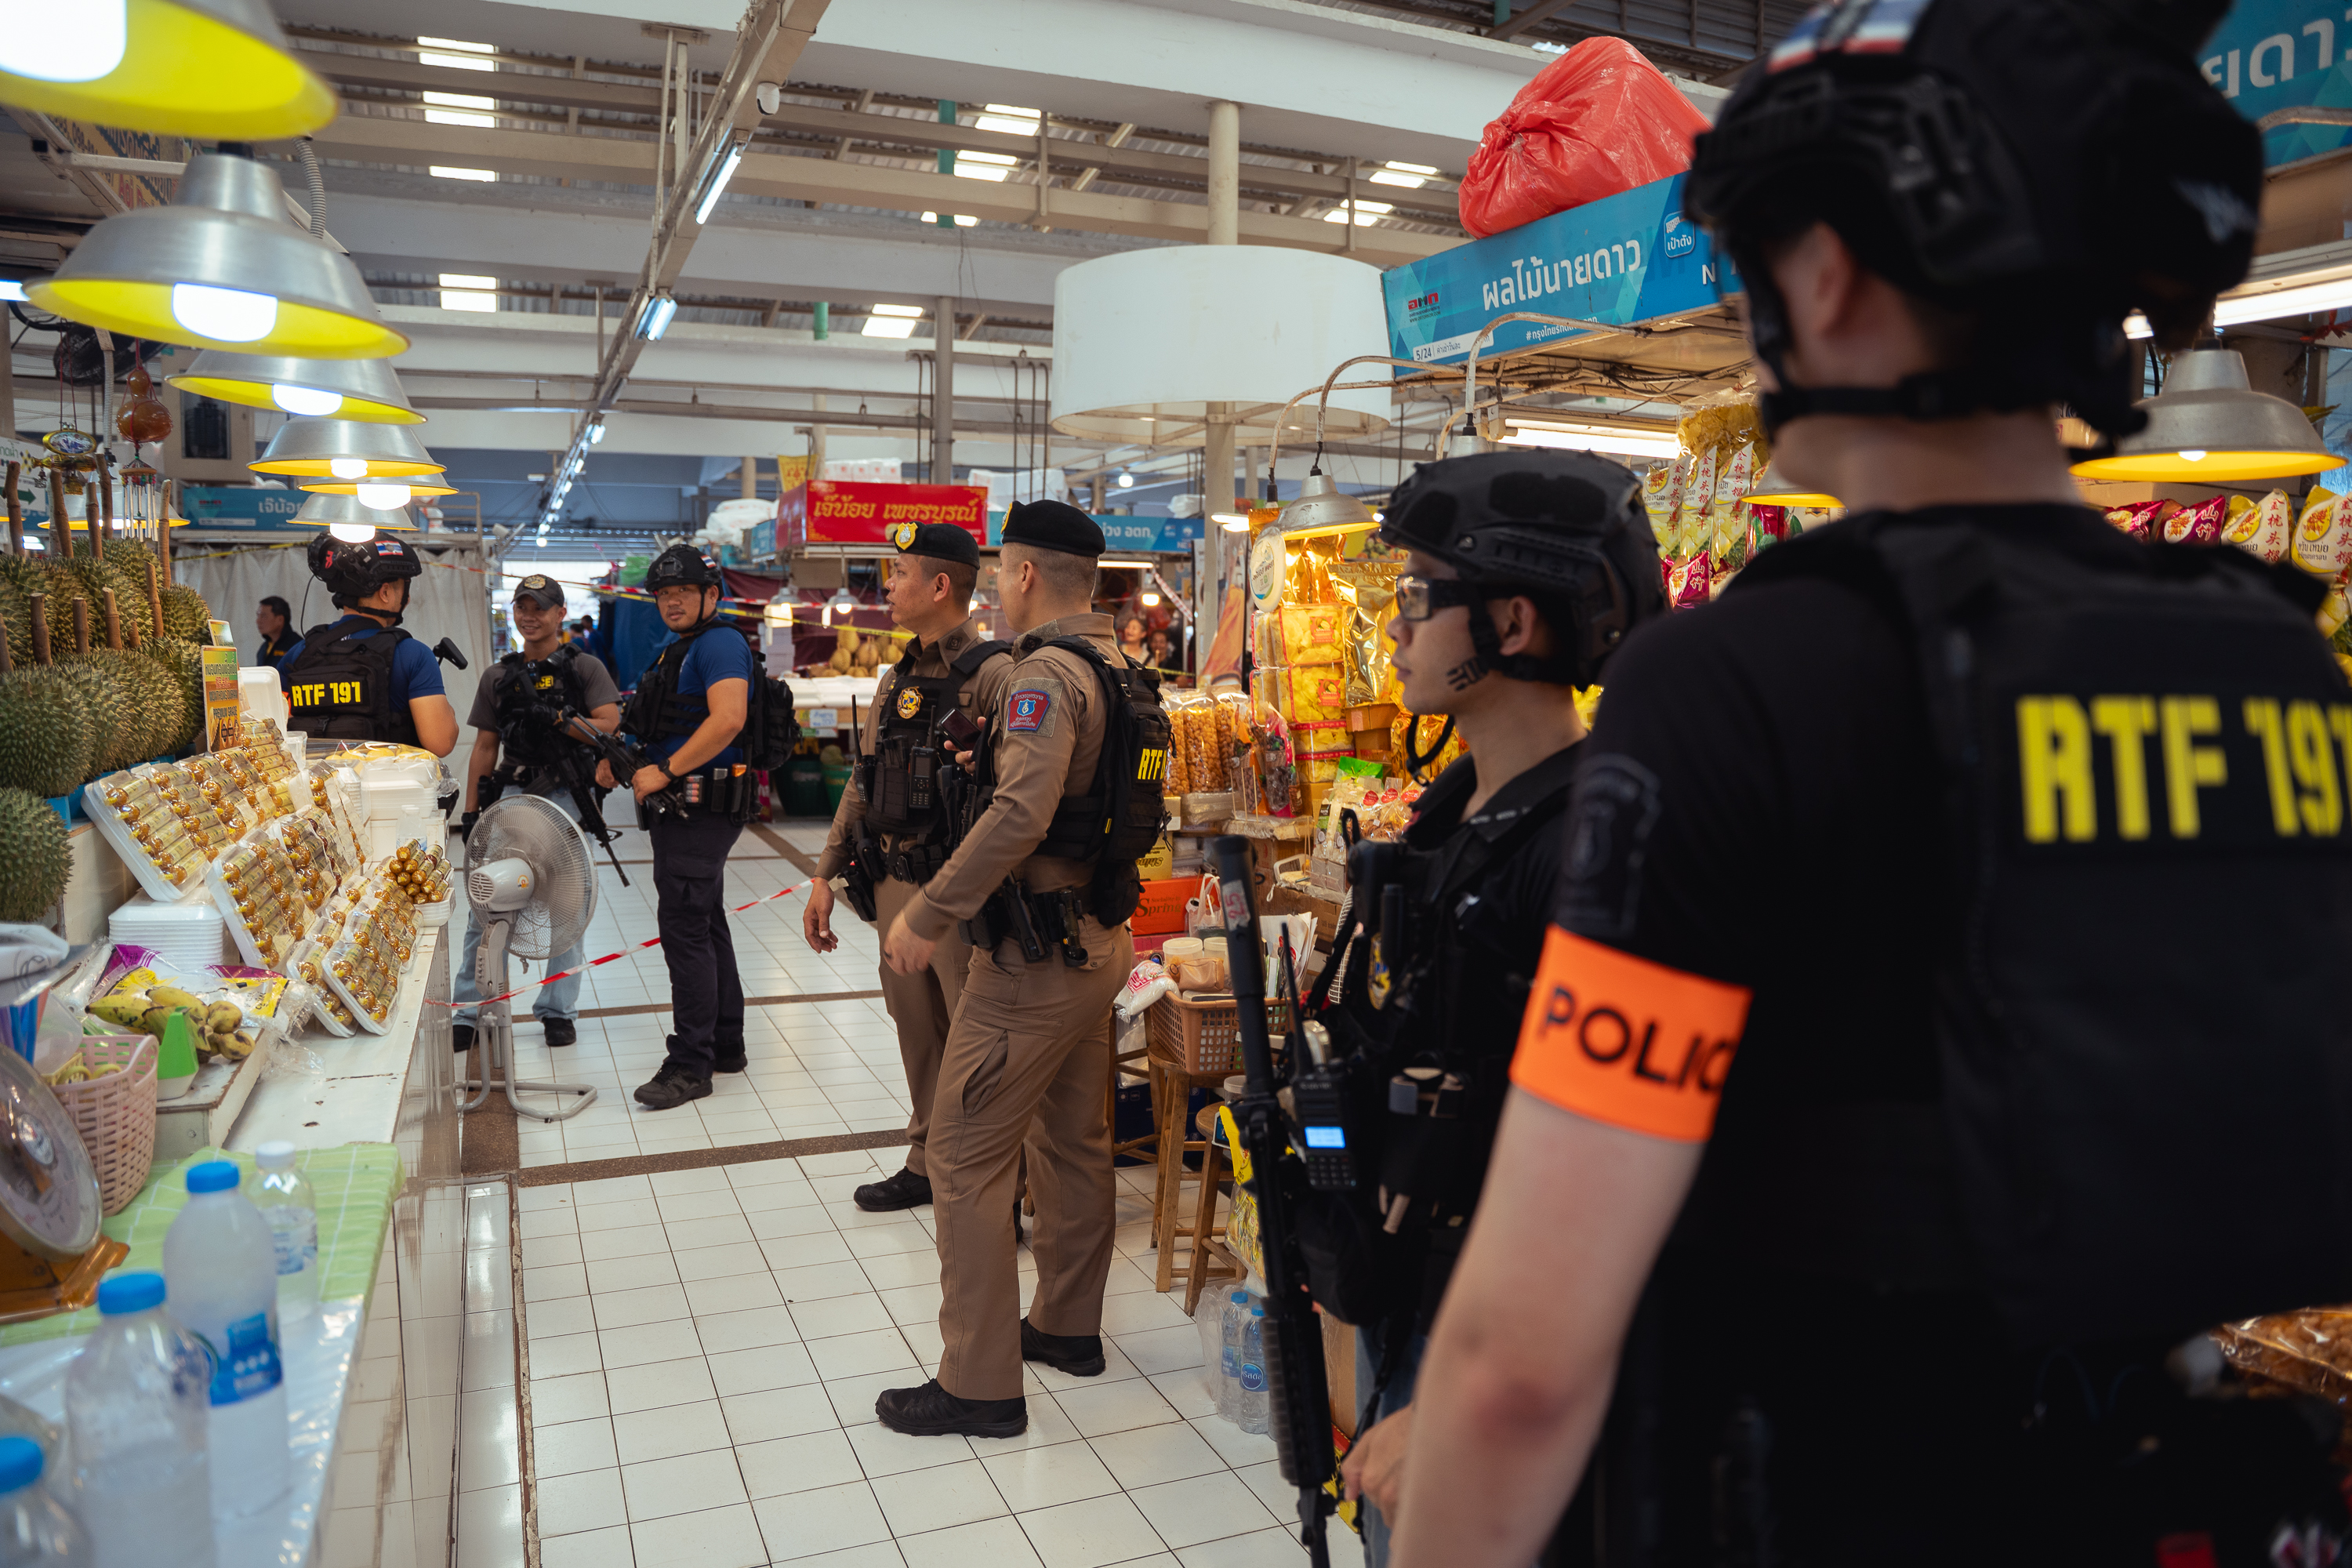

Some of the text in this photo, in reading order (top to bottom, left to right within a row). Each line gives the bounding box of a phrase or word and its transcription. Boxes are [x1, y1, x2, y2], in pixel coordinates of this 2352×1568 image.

[2201, 8, 2352, 100] ยดา
[1667, 234, 1692, 251] เป๋าตัง
[1483, 239, 1641, 310] ผลไม้นายดาว
[1416, 347, 1432, 361] 5/24
[813, 494, 979, 524] เจ๊น้อย เพชรบูรณ์
[1690, 561, 1707, 592] 山竹
[292, 681, 361, 706] RTF 191
[1137, 748, 1163, 780] RTF
[2013, 692, 2228, 845] RTF
[1134, 898, 1181, 918] Spring
[1537, 983, 1740, 1094] POLIC
